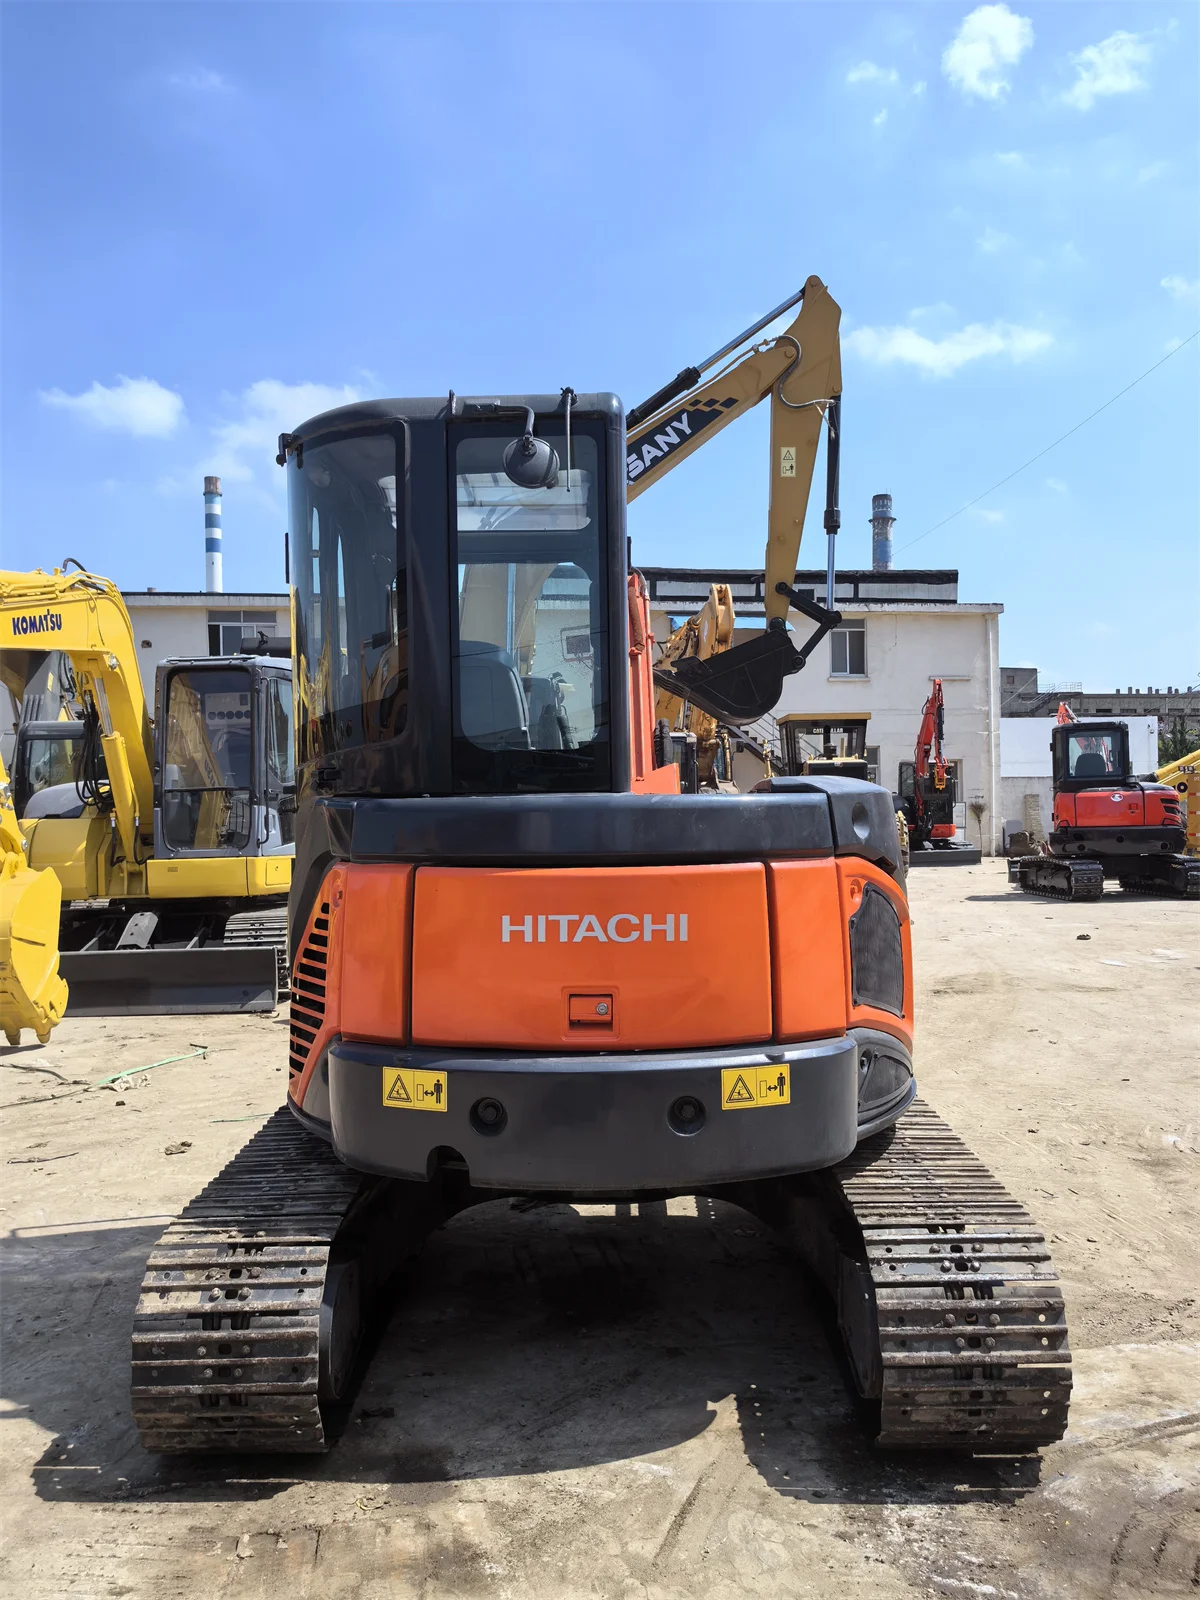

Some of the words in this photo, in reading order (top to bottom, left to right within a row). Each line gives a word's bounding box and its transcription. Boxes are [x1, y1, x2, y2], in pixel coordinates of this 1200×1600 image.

[626, 412, 692, 479] SANY
[12, 609, 62, 635] KOMATSU
[501, 913, 688, 943] HITACHI
